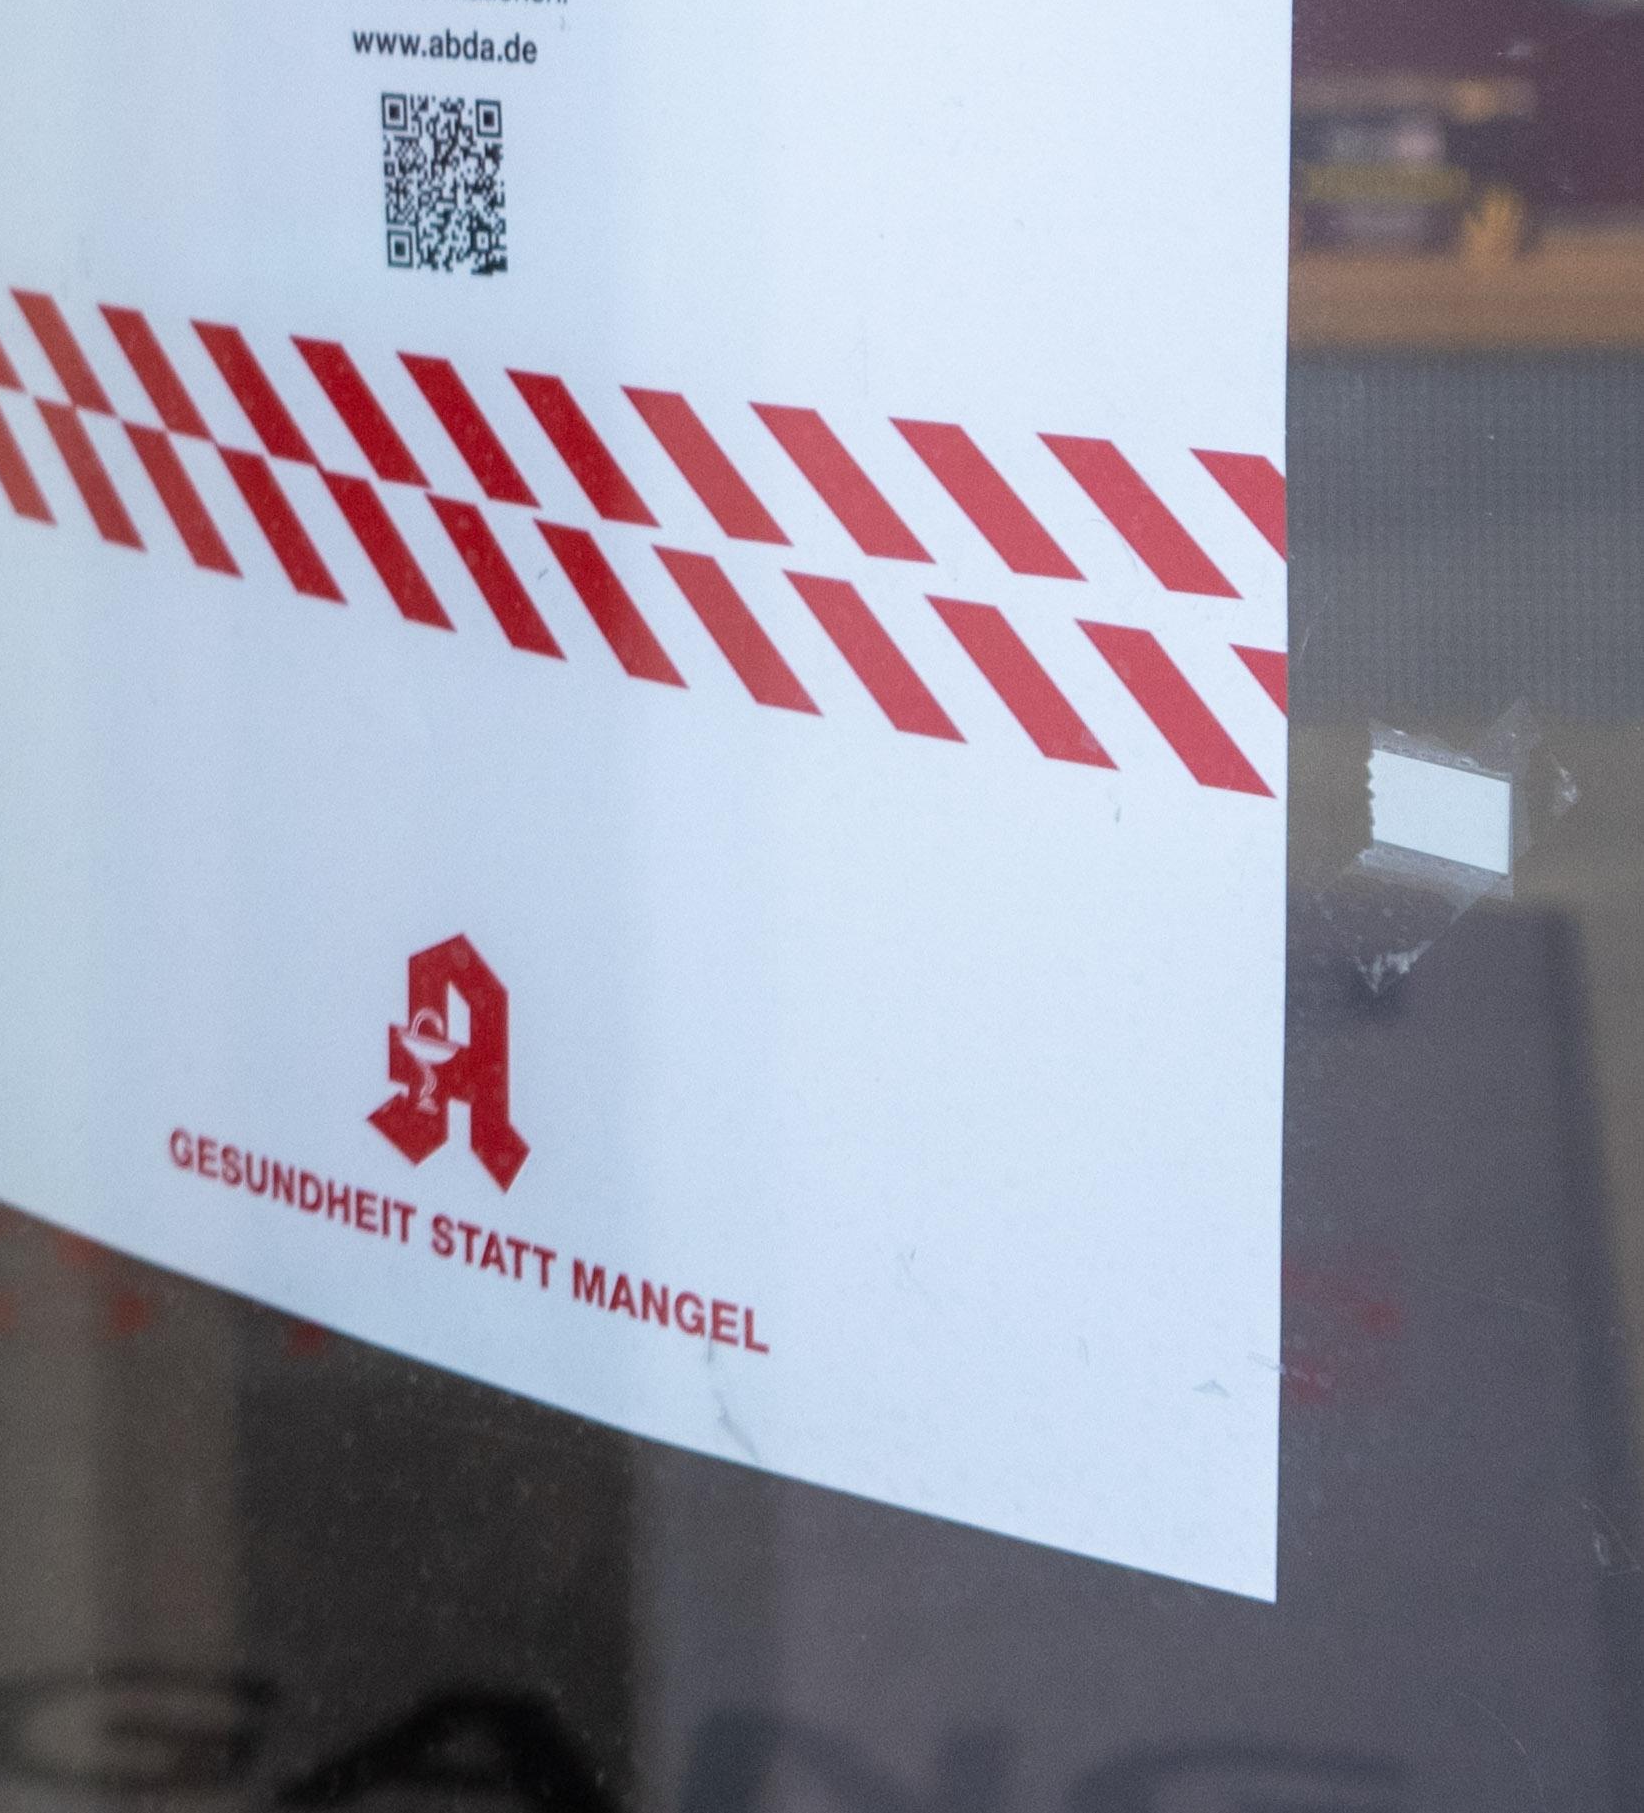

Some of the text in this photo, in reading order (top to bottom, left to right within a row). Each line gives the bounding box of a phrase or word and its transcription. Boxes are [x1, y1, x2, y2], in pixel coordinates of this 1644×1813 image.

[353, 29, 537, 64] www.abda.de
[169, 1126, 769, 1353] GESUNDHEIT STATT MANGEL
